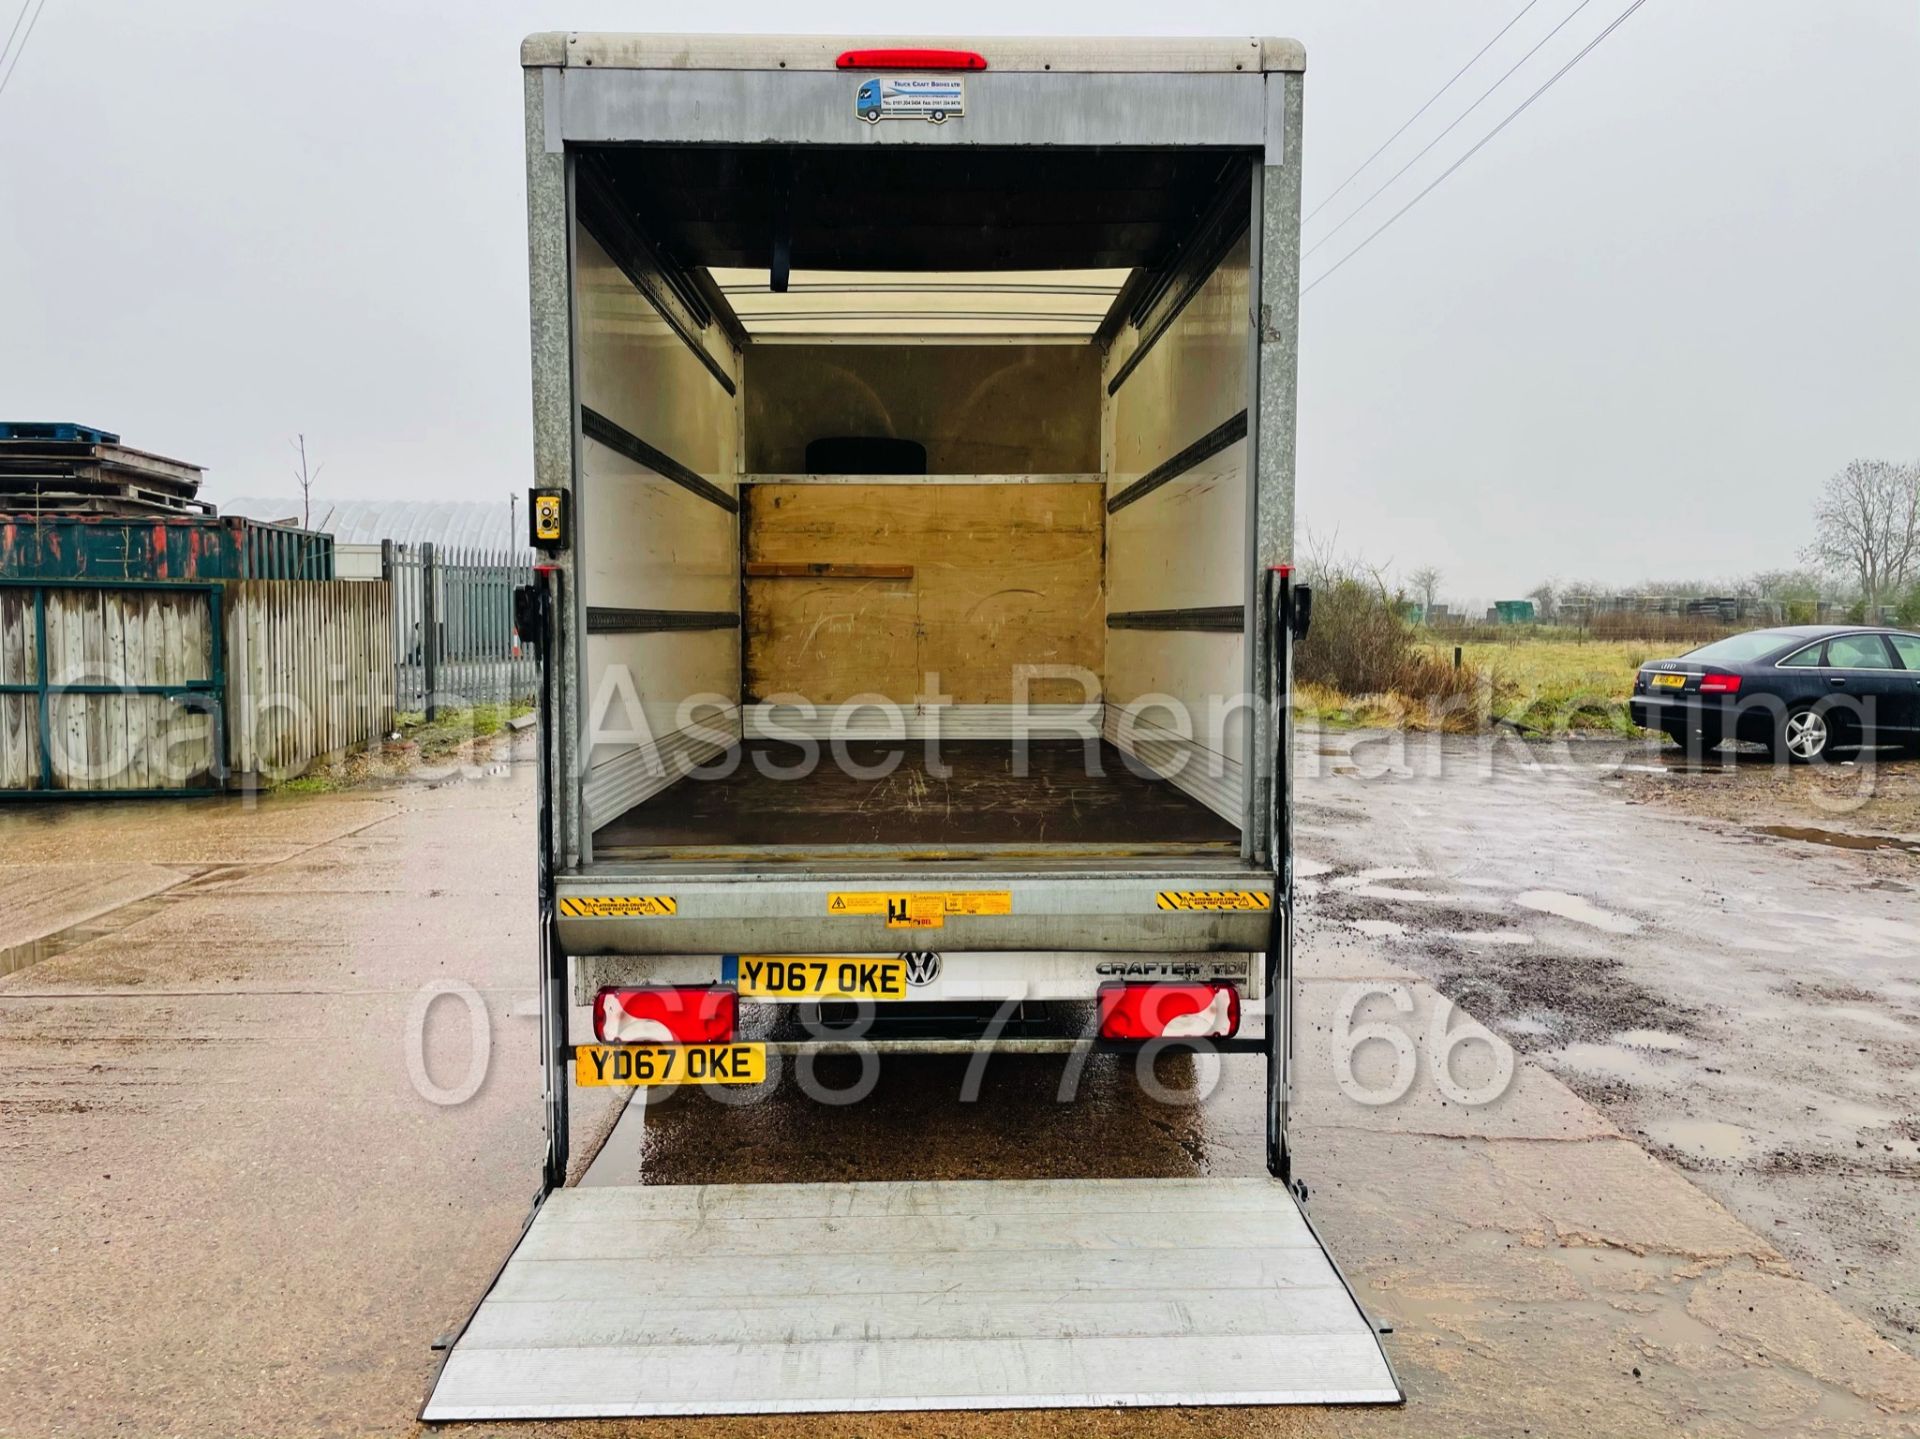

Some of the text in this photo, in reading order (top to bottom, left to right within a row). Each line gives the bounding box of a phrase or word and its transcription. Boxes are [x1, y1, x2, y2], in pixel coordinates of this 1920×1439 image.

[745, 961, 900, 994] YD67 OKE
[1095, 961, 1200, 975] CRAFTER
[590, 1046, 752, 1081] YD67 OKE
